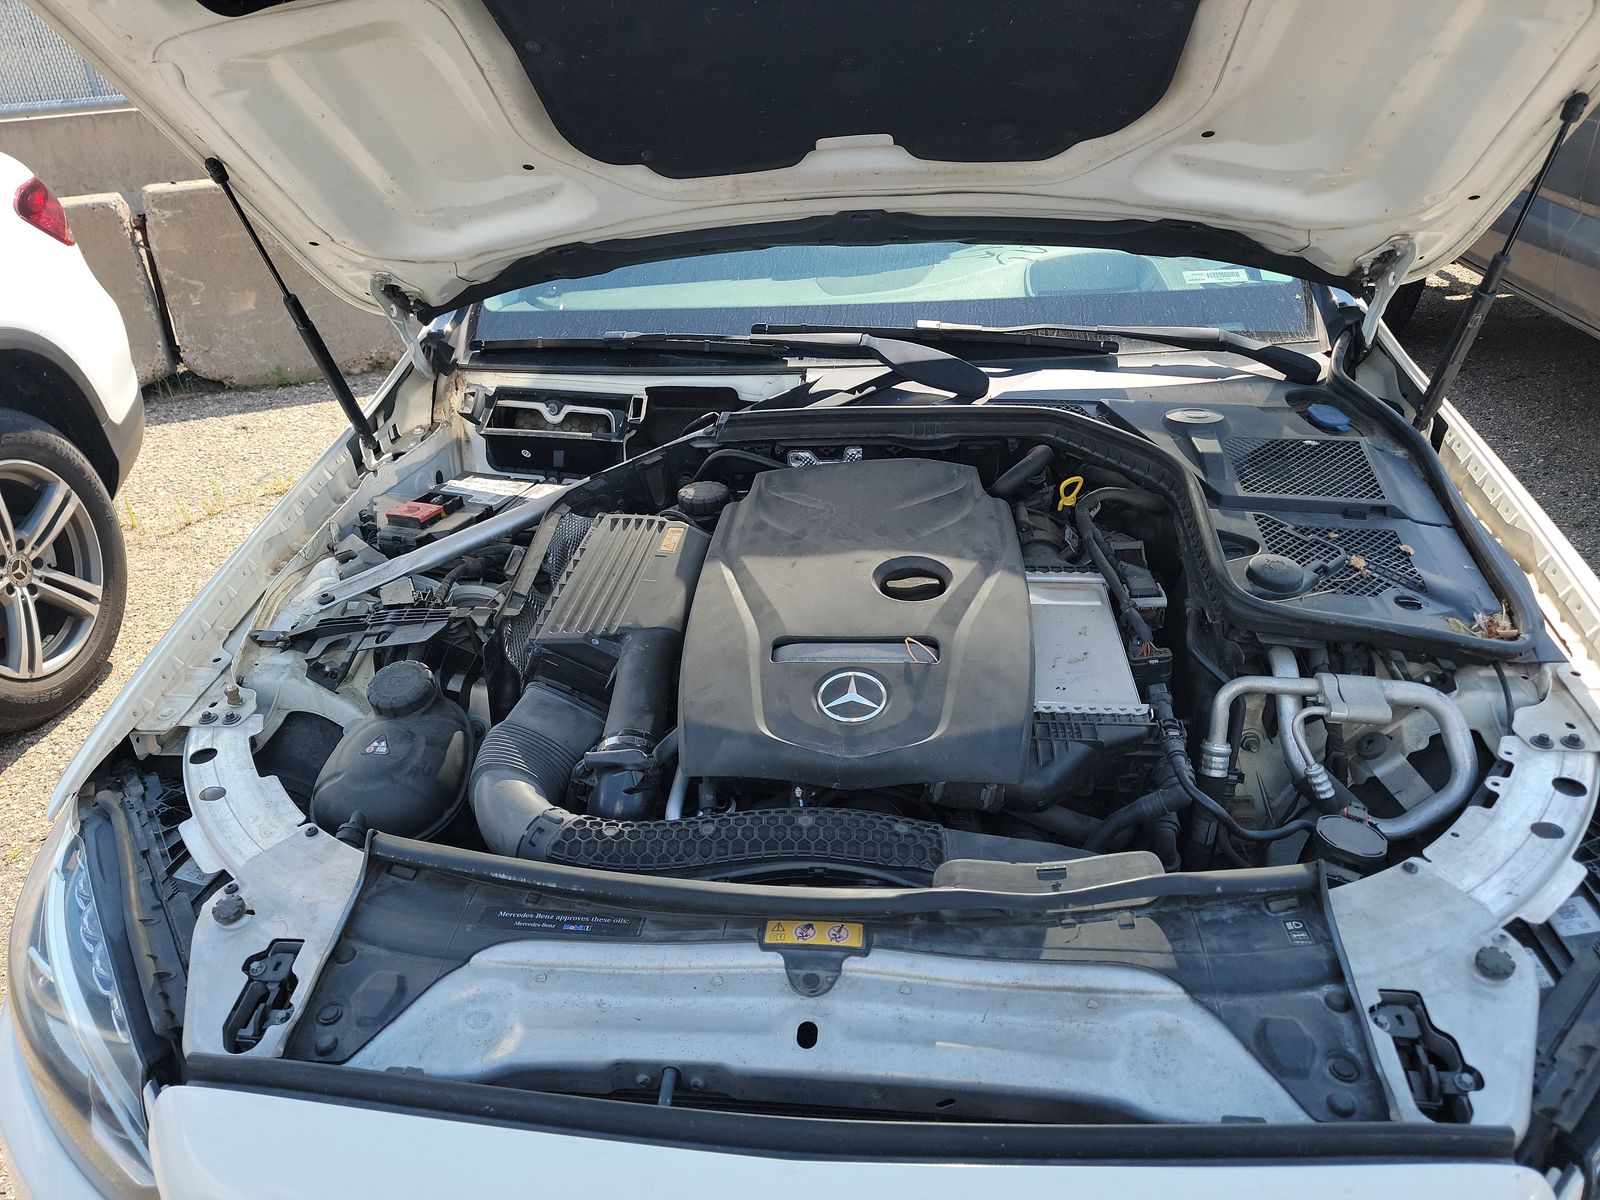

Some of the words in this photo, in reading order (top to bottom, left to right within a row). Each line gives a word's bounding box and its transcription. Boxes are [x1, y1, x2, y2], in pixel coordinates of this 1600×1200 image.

[497, 910, 554, 920] Mercedes-Benz
[555, 914, 589, 922] approves
[591, 915, 612, 923] these
[513, 920, 556, 929] Mercedes-Benz
